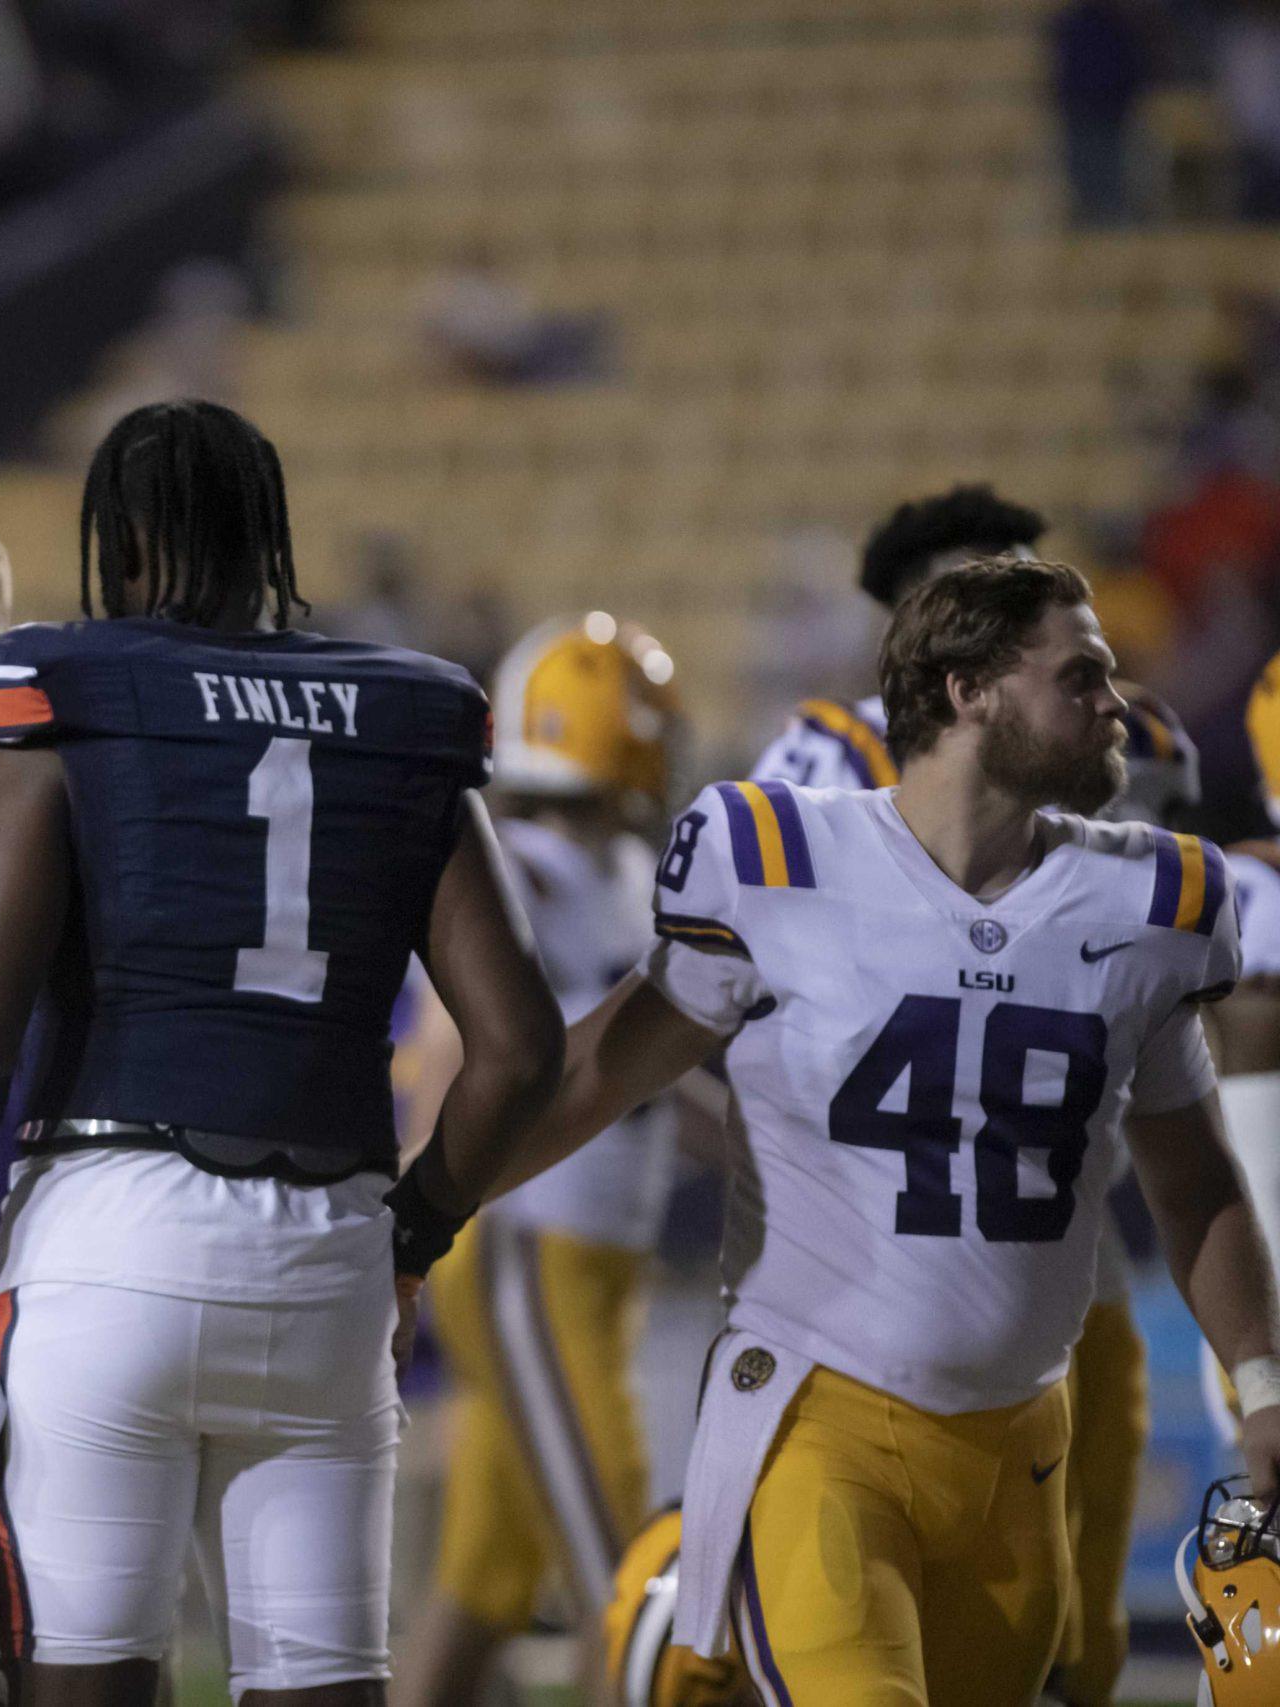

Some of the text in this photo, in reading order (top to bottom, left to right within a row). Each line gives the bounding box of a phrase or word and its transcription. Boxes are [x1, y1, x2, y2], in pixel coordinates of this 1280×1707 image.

[193, 671, 360, 737] FINLEY
[233, 736, 330, 1004] 1
[655, 809, 708, 893] 8
[959, 968, 1015, 993] LSU
[828, 994, 1108, 1243] 48
